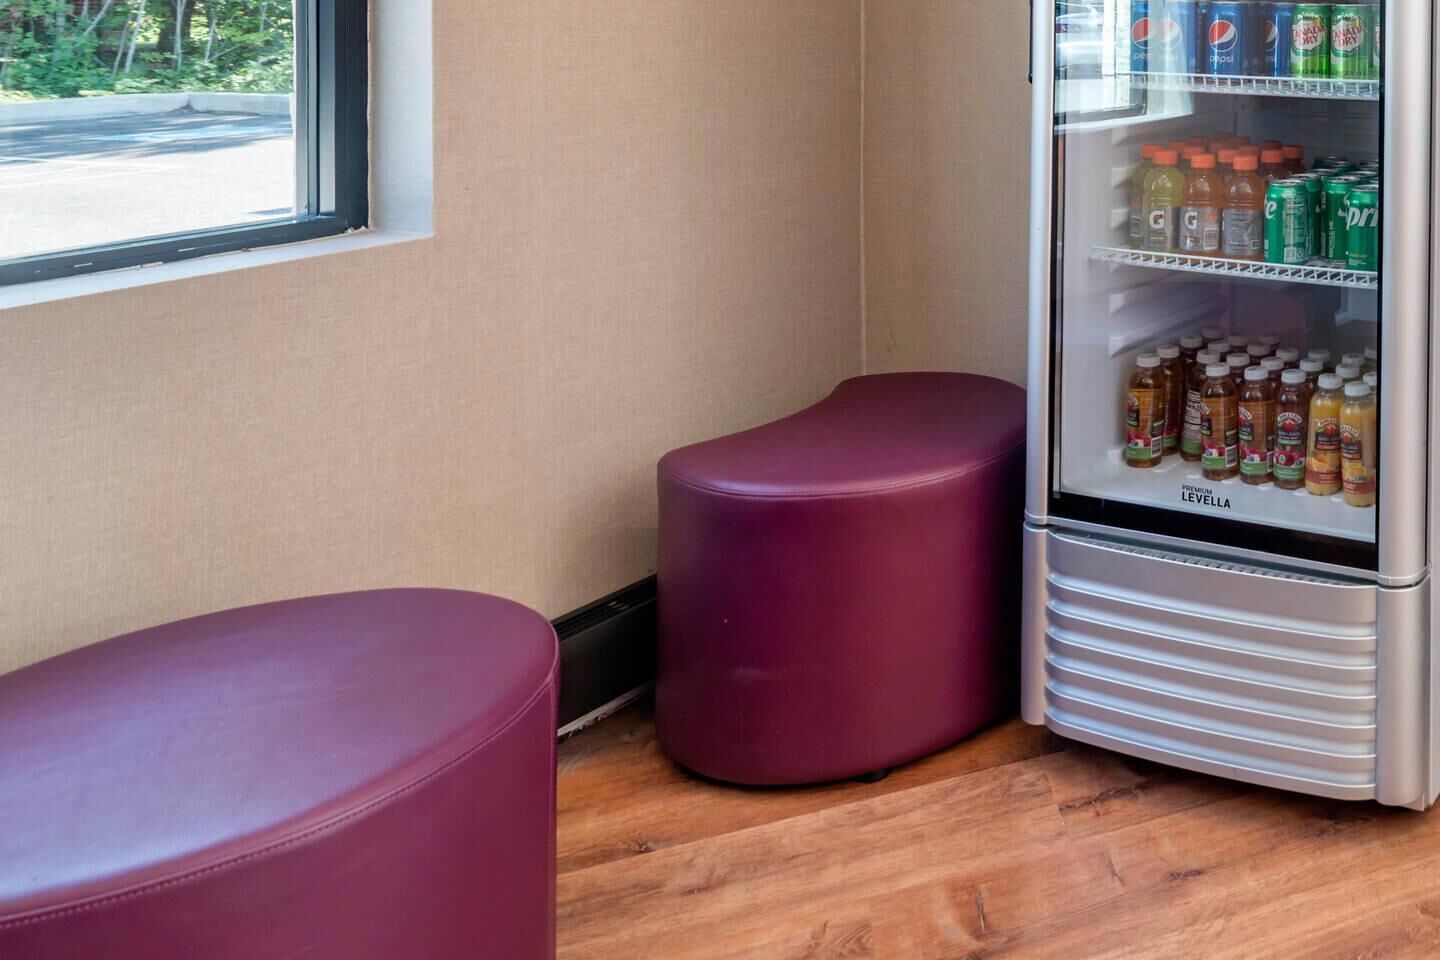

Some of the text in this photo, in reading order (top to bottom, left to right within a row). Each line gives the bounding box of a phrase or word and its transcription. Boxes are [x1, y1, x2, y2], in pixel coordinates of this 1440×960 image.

[1209, 54, 1234, 64] pepsi
[1181, 484, 1213, 495] PREMIUM
[1182, 491, 1231, 509] LEVELLA
